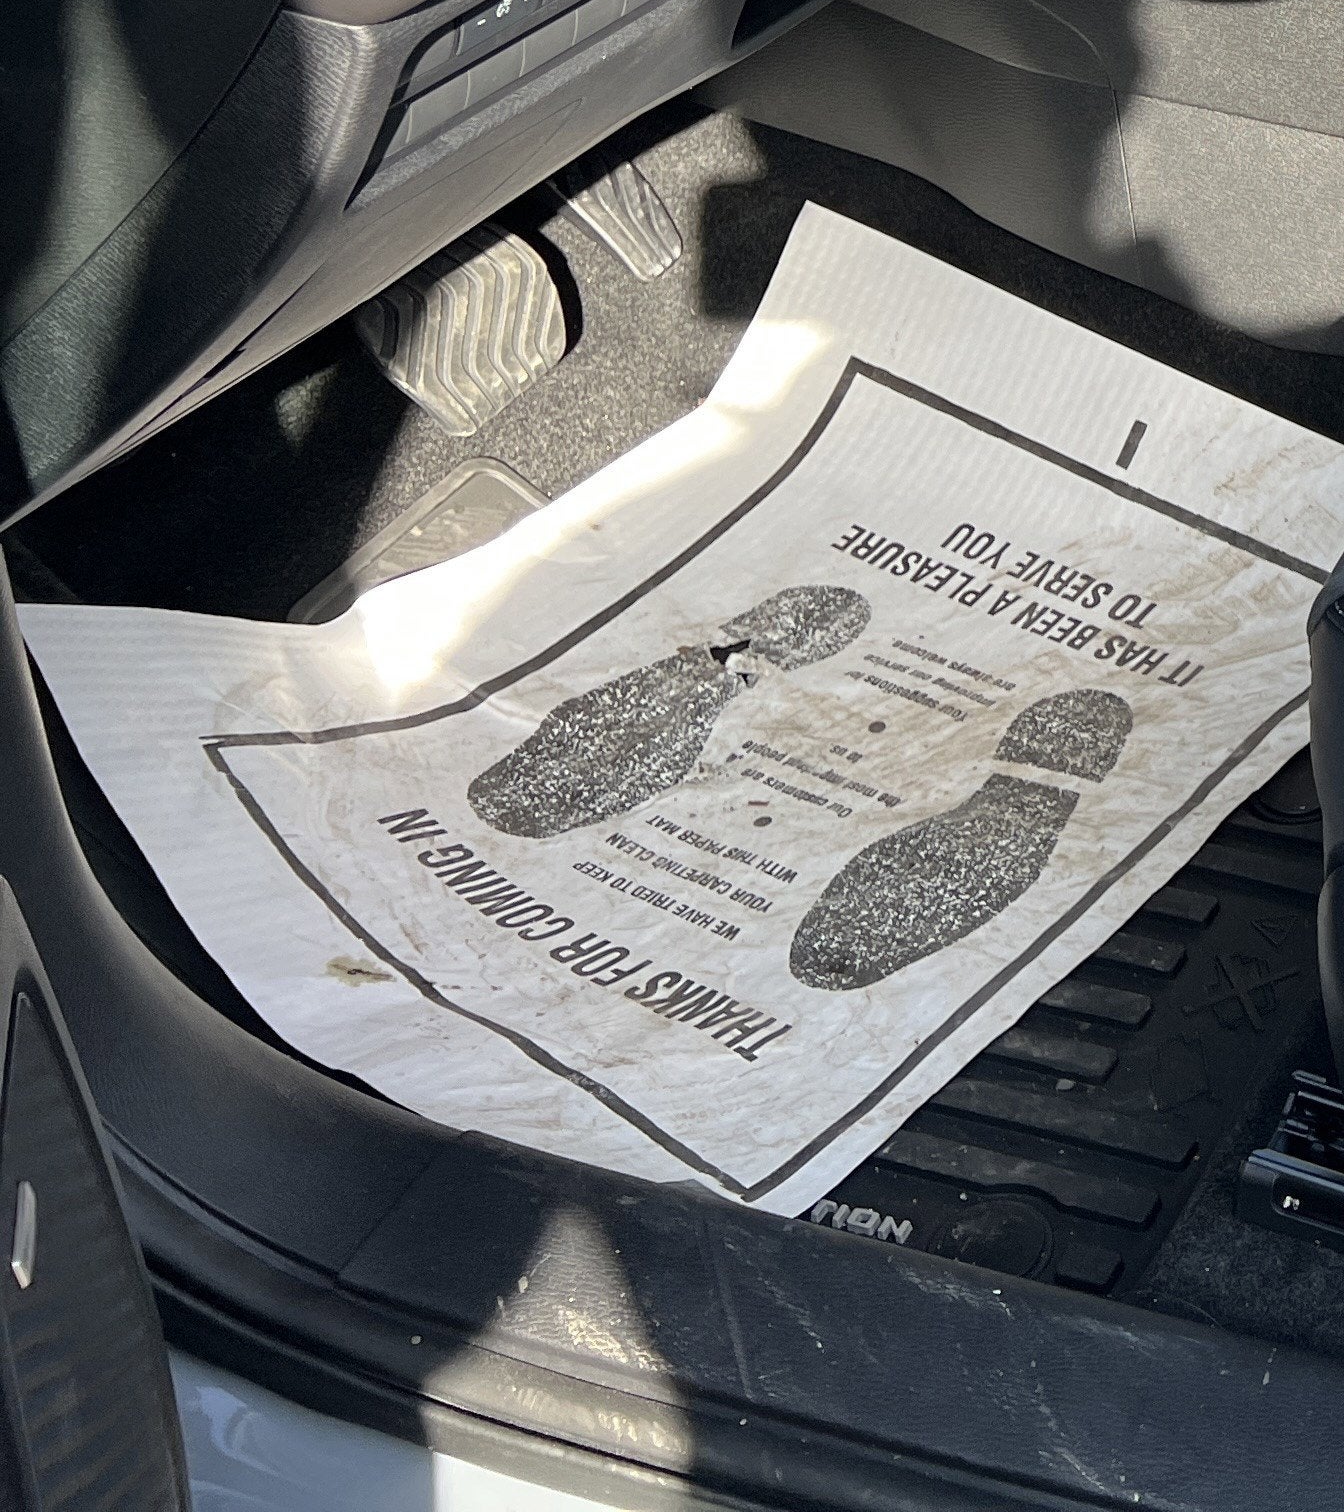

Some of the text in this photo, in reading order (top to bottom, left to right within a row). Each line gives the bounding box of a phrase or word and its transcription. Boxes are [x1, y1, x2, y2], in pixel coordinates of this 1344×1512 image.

[940, 523, 1158, 630] TO SERVE YOU
[830, 524, 1205, 688] IT HAS BEEN A PLEASURE
[863, 654, 911, 673] service
[947, 661, 993, 683] always
[863, 675, 940, 709] suggestions
[931, 677, 997, 708] improving
[938, 704, 968, 722] Your
[741, 739, 789, 762] people
[845, 751, 863, 764] to
[762, 776, 829, 807] customers
[841, 780, 879, 798] most
[877, 792, 902, 808] the
[826, 802, 853, 819] Our
[645, 815, 798, 884] WITH THIS PAPER MAT
[605, 832, 773, 913] YOUR CARPETING CLEAN
[572, 861, 741, 941] WE HAVE TRIED TO KEEP
[376, 808, 793, 1063] THANKS FOR COMING IN
